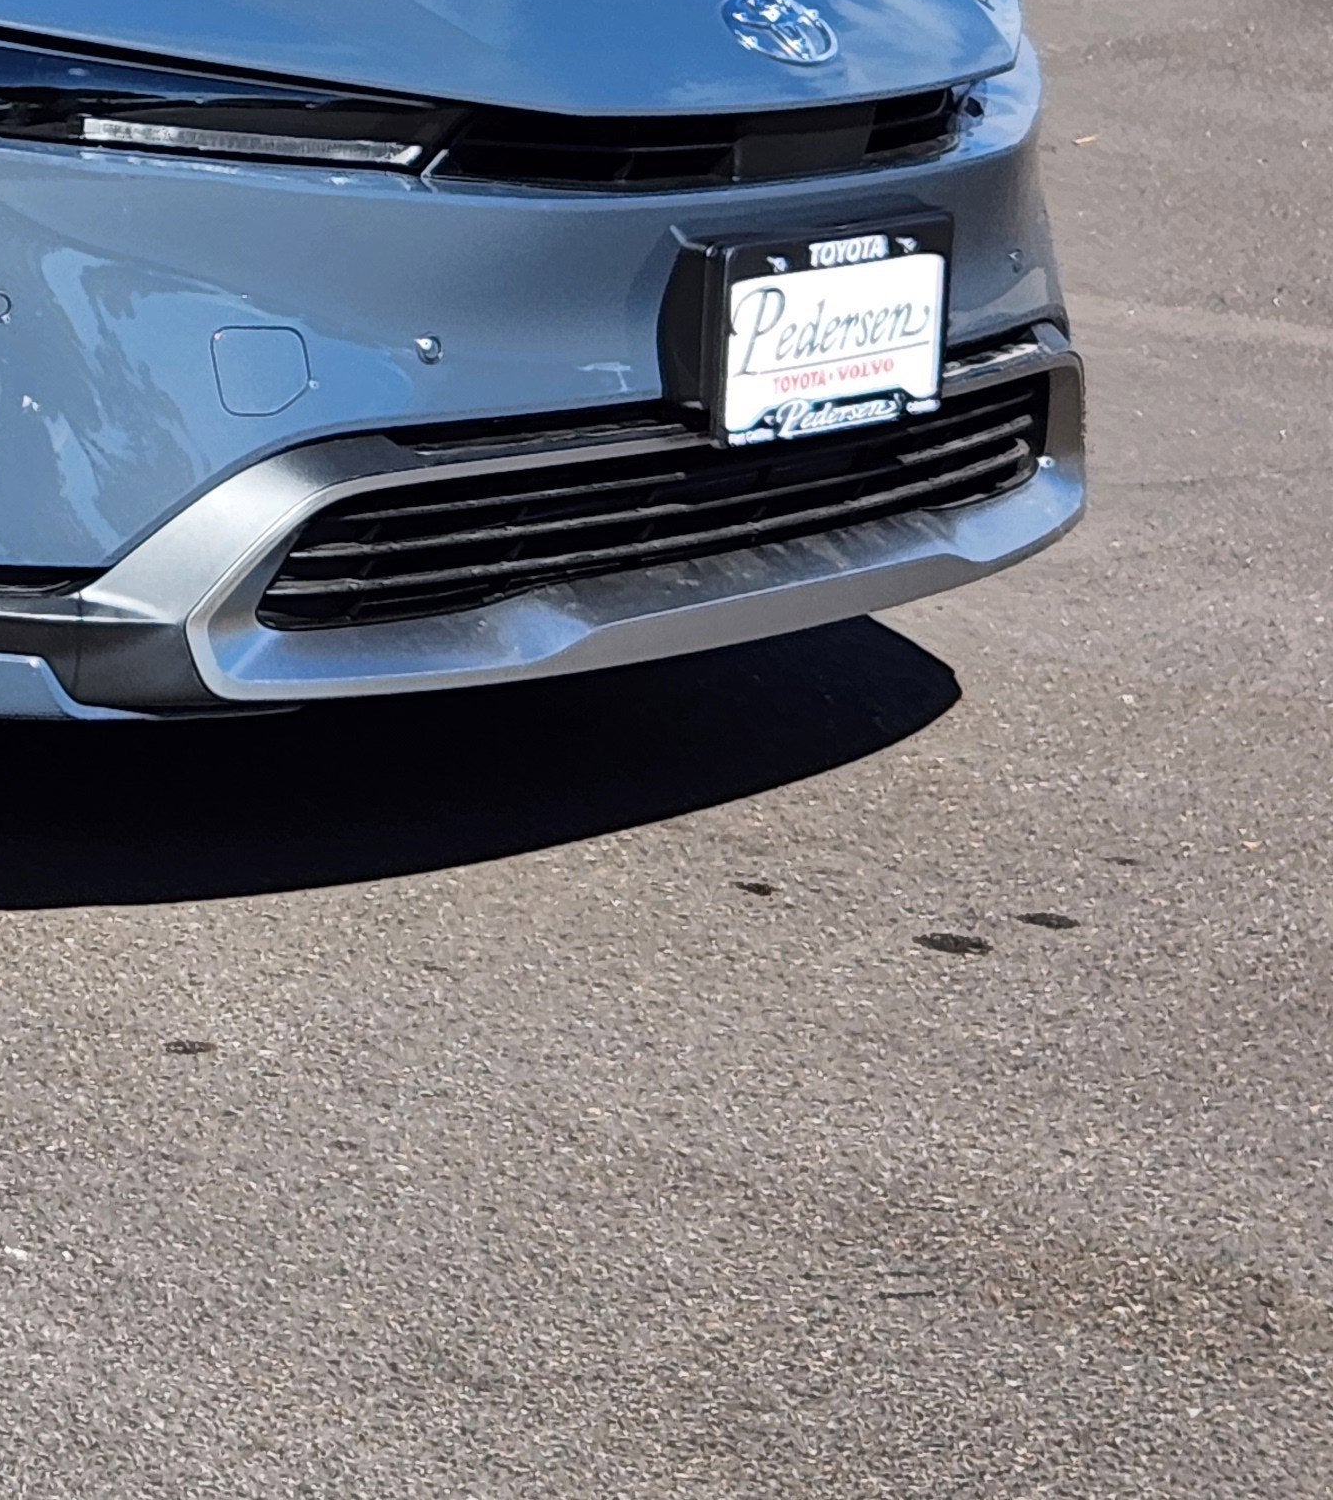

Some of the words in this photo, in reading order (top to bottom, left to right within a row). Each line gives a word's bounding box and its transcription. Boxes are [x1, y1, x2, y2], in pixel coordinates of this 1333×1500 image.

[809, 235, 888, 267] TOYOTA
[729, 285, 931, 376] Pedersen
[773, 371, 827, 393] TOYOTA
[837, 358, 894, 381] VOLVO
[777, 399, 901, 438] Pedersen
